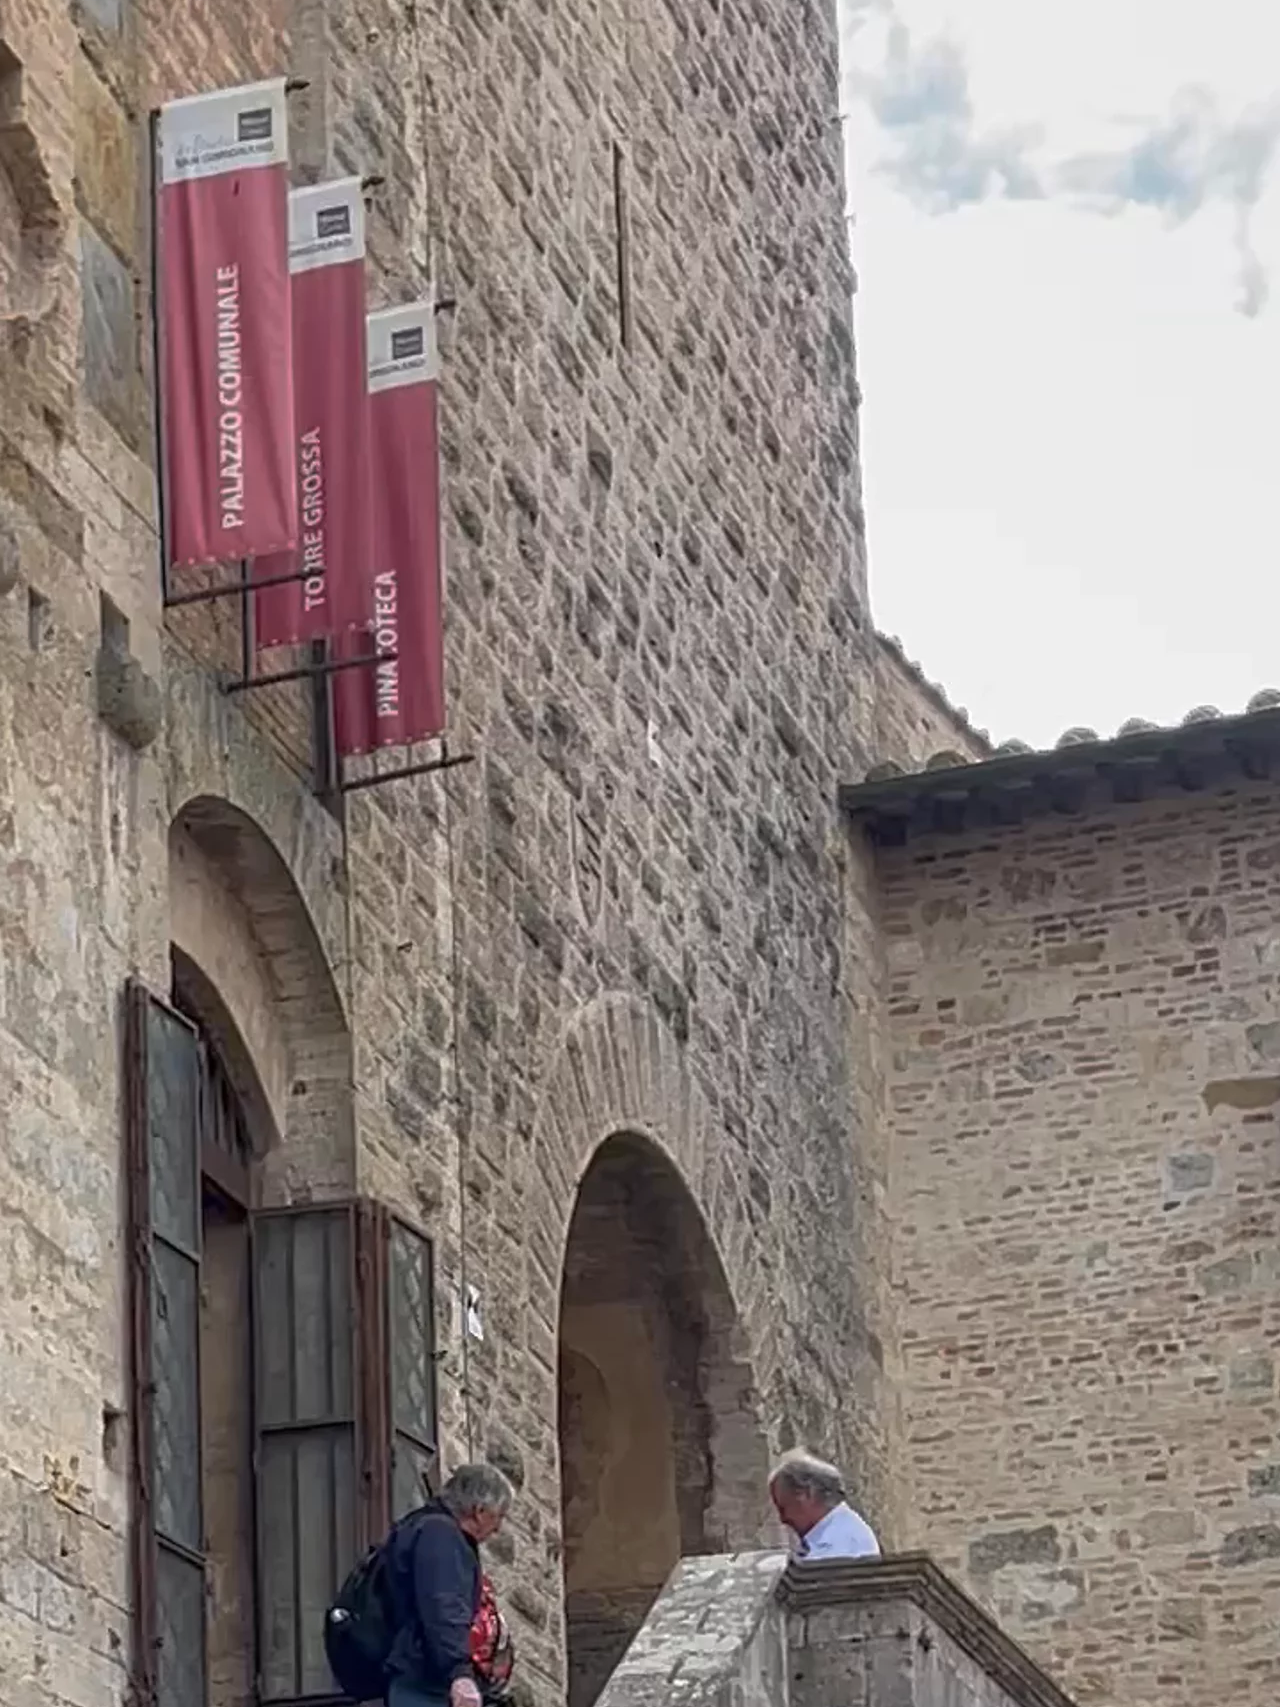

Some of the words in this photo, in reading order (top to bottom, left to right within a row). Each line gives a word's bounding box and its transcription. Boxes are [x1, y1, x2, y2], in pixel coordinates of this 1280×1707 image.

[217, 262, 241, 406] COMUNALE
[220, 412, 244, 529] PALAZZO
[300, 426, 325, 526] GROSSA
